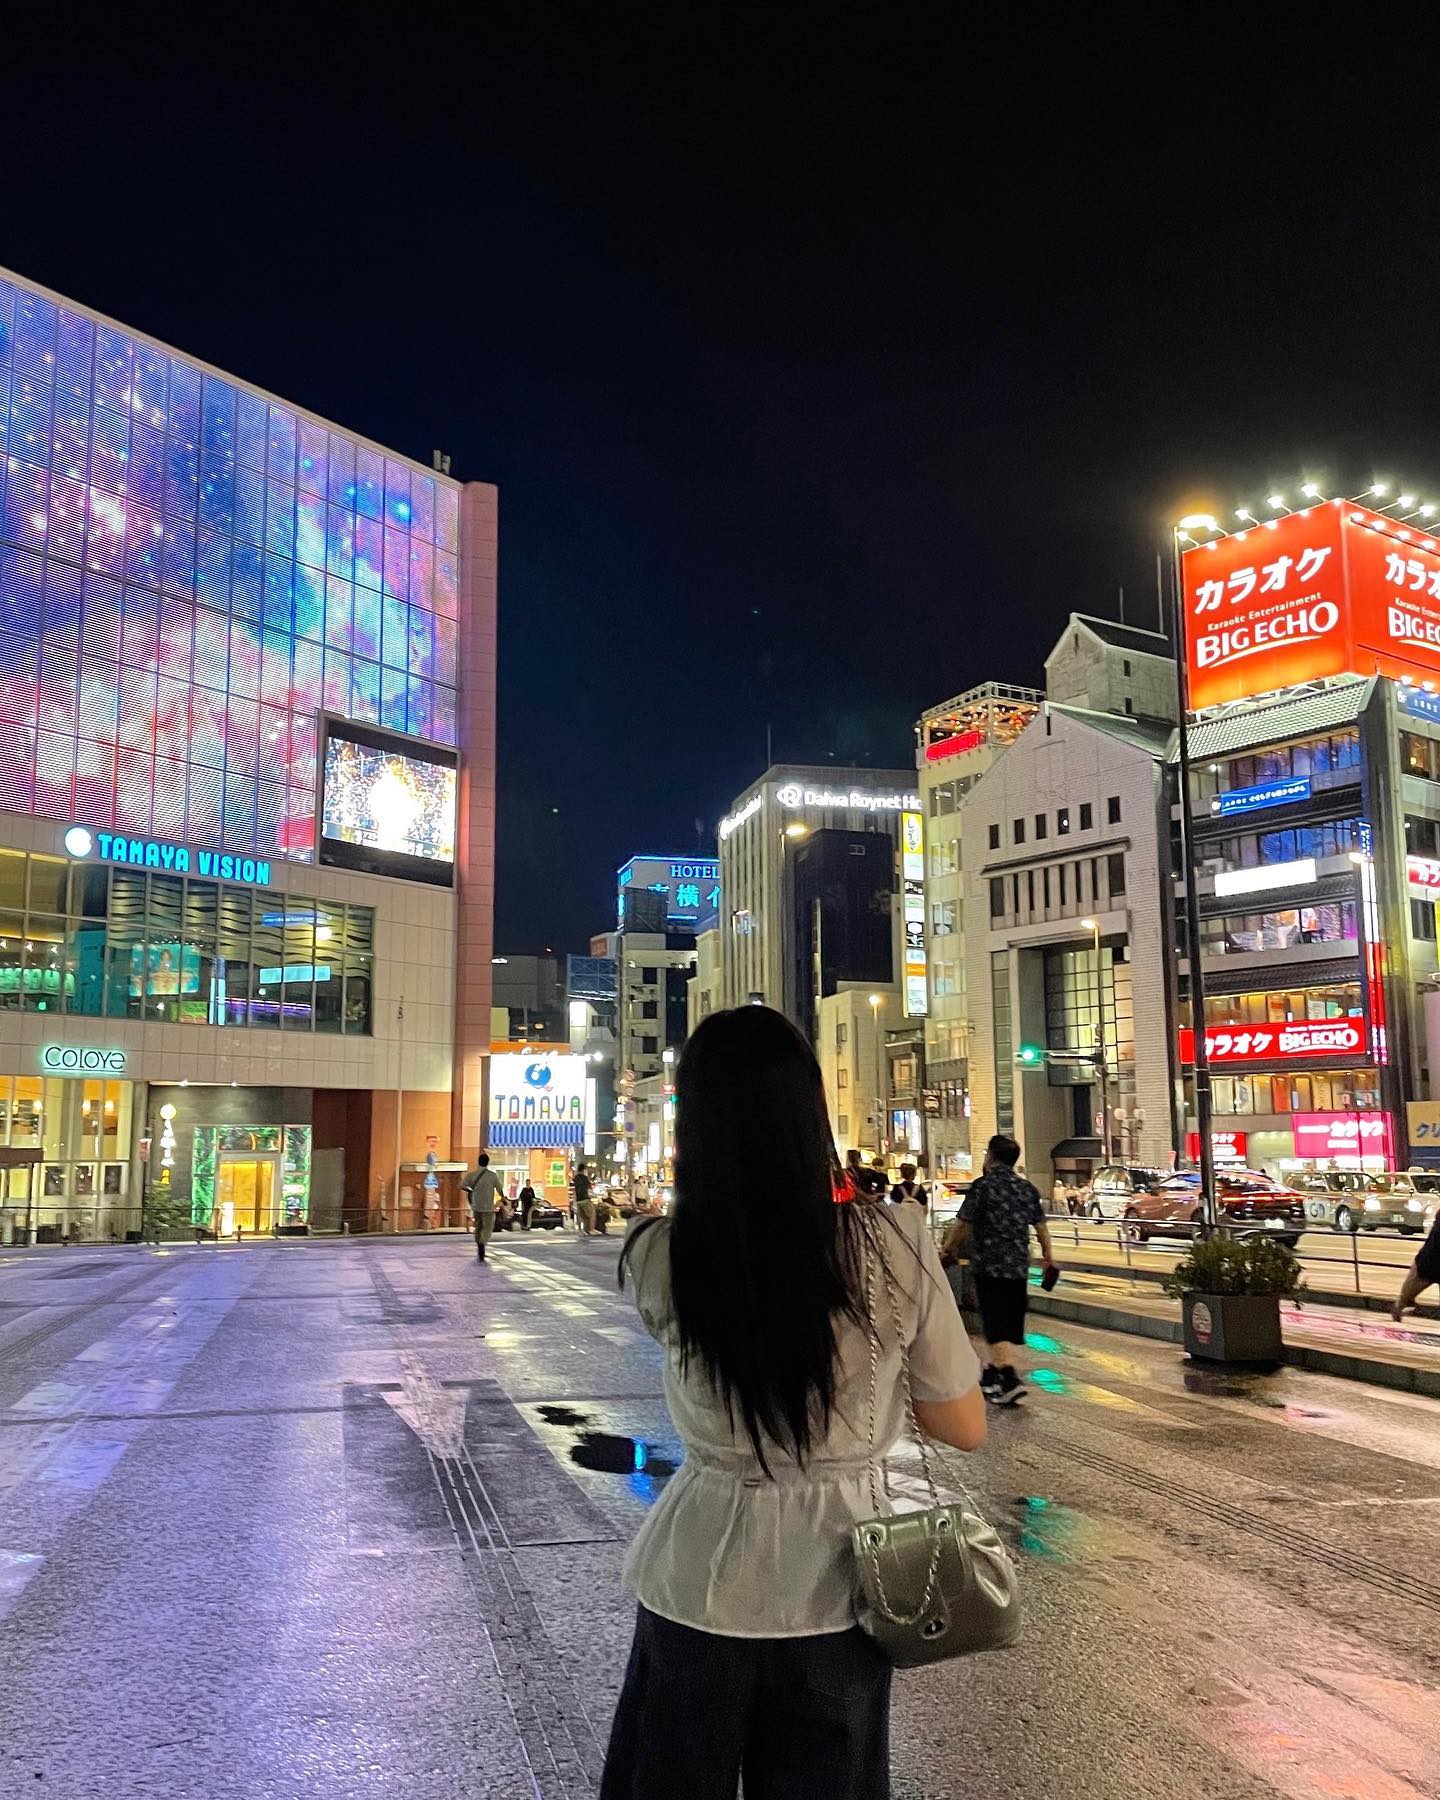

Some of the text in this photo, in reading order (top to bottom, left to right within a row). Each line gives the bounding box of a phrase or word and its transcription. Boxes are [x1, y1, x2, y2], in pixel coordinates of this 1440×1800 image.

[1194, 547, 1332, 614] カラオケ
[1208, 592, 1322, 632] Karaoke Entertainment
[1388, 605, 1424, 639] BIG
[1197, 601, 1339, 668] BIG ECHO
[804, 792, 849, 807] Daiwa
[850, 793, 901, 811] Roynet
[98, 833, 270, 885] TAMAYA VISION
[670, 865, 720, 879] HOTEL
[1279, 1030, 1309, 1052] BIG
[1311, 1028, 1359, 1047] ECHO
[494, 1094, 581, 1119] TAMAYA
